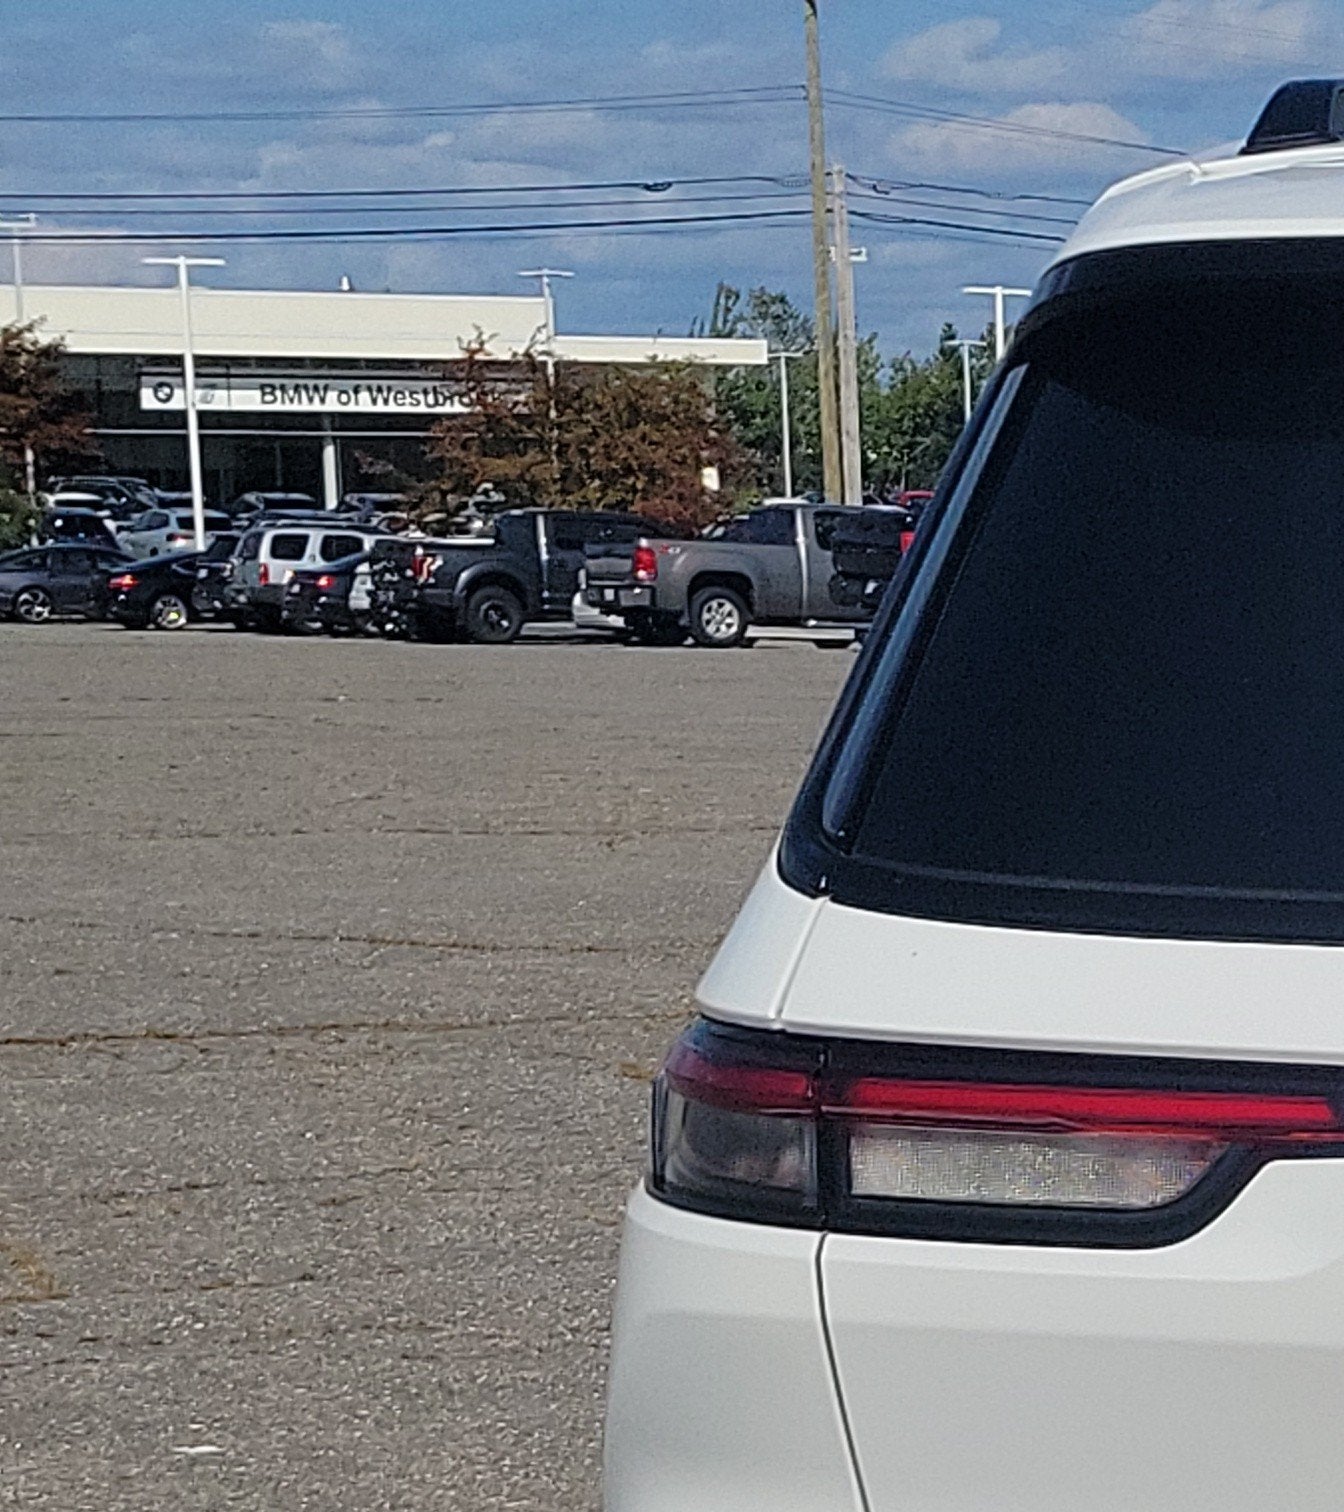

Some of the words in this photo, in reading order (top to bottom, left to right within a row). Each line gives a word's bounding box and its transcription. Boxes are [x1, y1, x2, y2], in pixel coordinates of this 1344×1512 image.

[259, 383, 330, 405] BMW
[337, 384, 361, 406] of
[367, 385, 497, 409] Westbro
